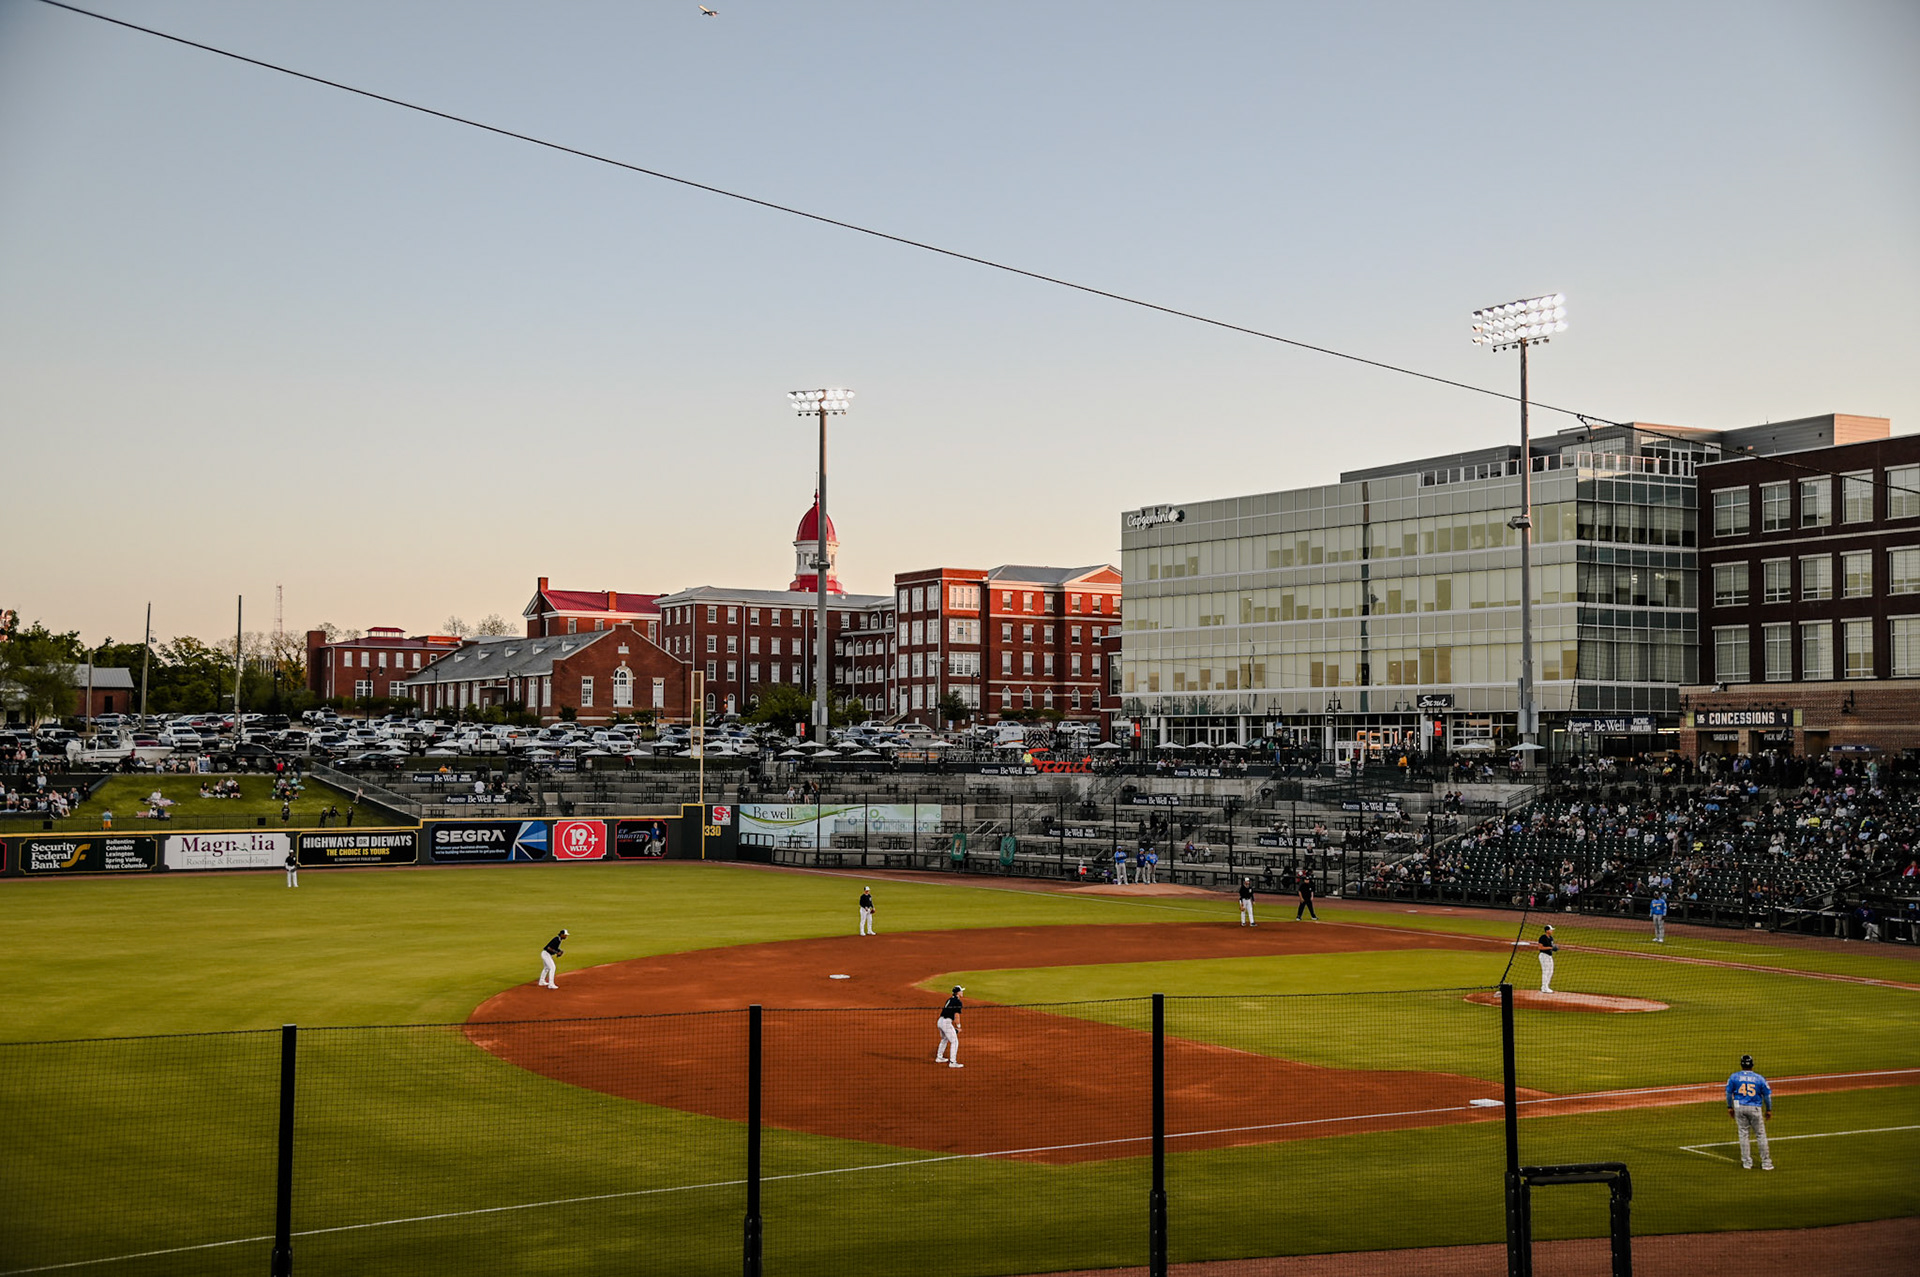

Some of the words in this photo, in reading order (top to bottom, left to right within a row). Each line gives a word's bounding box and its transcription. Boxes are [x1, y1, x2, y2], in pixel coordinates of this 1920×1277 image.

[1127, 511, 1169, 530] Capgemini
[1419, 695, 1448, 707] Scout
[1709, 712, 1775, 725] CONCESSIONS
[1781, 713, 1787, 723] 4
[1593, 719, 1605, 732] Be
[1605, 719, 1625, 732] Well
[1000, 767, 1008, 775] Be
[1008, 767, 1023, 775] Well
[443, 774, 457, 782] Well
[467, 795, 476, 803] Be
[476, 795, 492, 803] Well
[1361, 802, 1369, 810] Be
[1369, 802, 1384, 811] Well
[753, 806, 769, 820] Be
[770, 807, 797, 820] well.
[435, 829, 506, 843] SEGRA
[704, 825, 721, 836] 330
[181, 835, 275, 857] Magnlia
[303, 836, 354, 848] HIGHWAYS
[371, 835, 412, 847] DIEWAYS
[1287, 838, 1301, 847] Wll
[31, 843, 76, 852] Security
[326, 848, 338, 856] THE
[339, 848, 361, 856] CHOICE
[370, 847, 390, 855] YOURS
[31, 851, 72, 860] Federal
[186, 856, 216, 866] Roofing
[226, 855, 269, 865] Remodeling
[31, 861, 60, 870] Bank
[1738, 1083, 1756, 1097] 45
